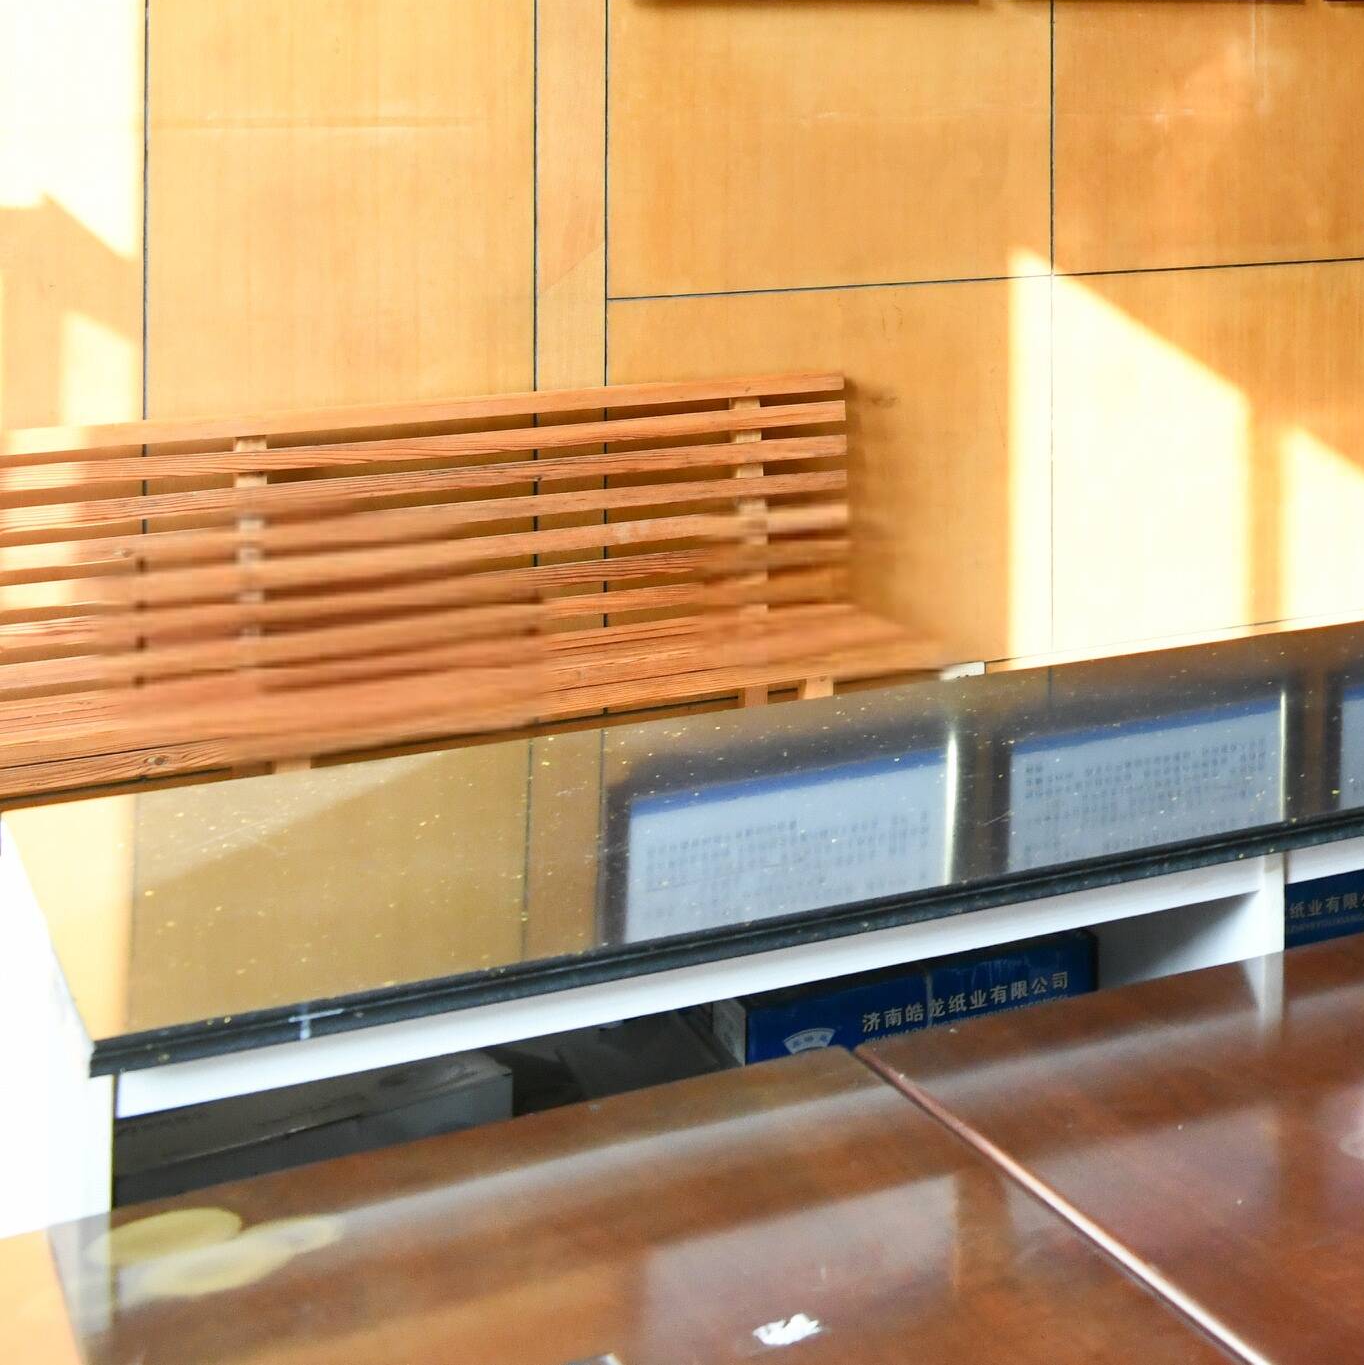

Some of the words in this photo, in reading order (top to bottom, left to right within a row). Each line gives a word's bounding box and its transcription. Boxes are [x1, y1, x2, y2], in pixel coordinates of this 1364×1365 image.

[862, 971, 1069, 1033] 济南皓龙纸业有限公司
